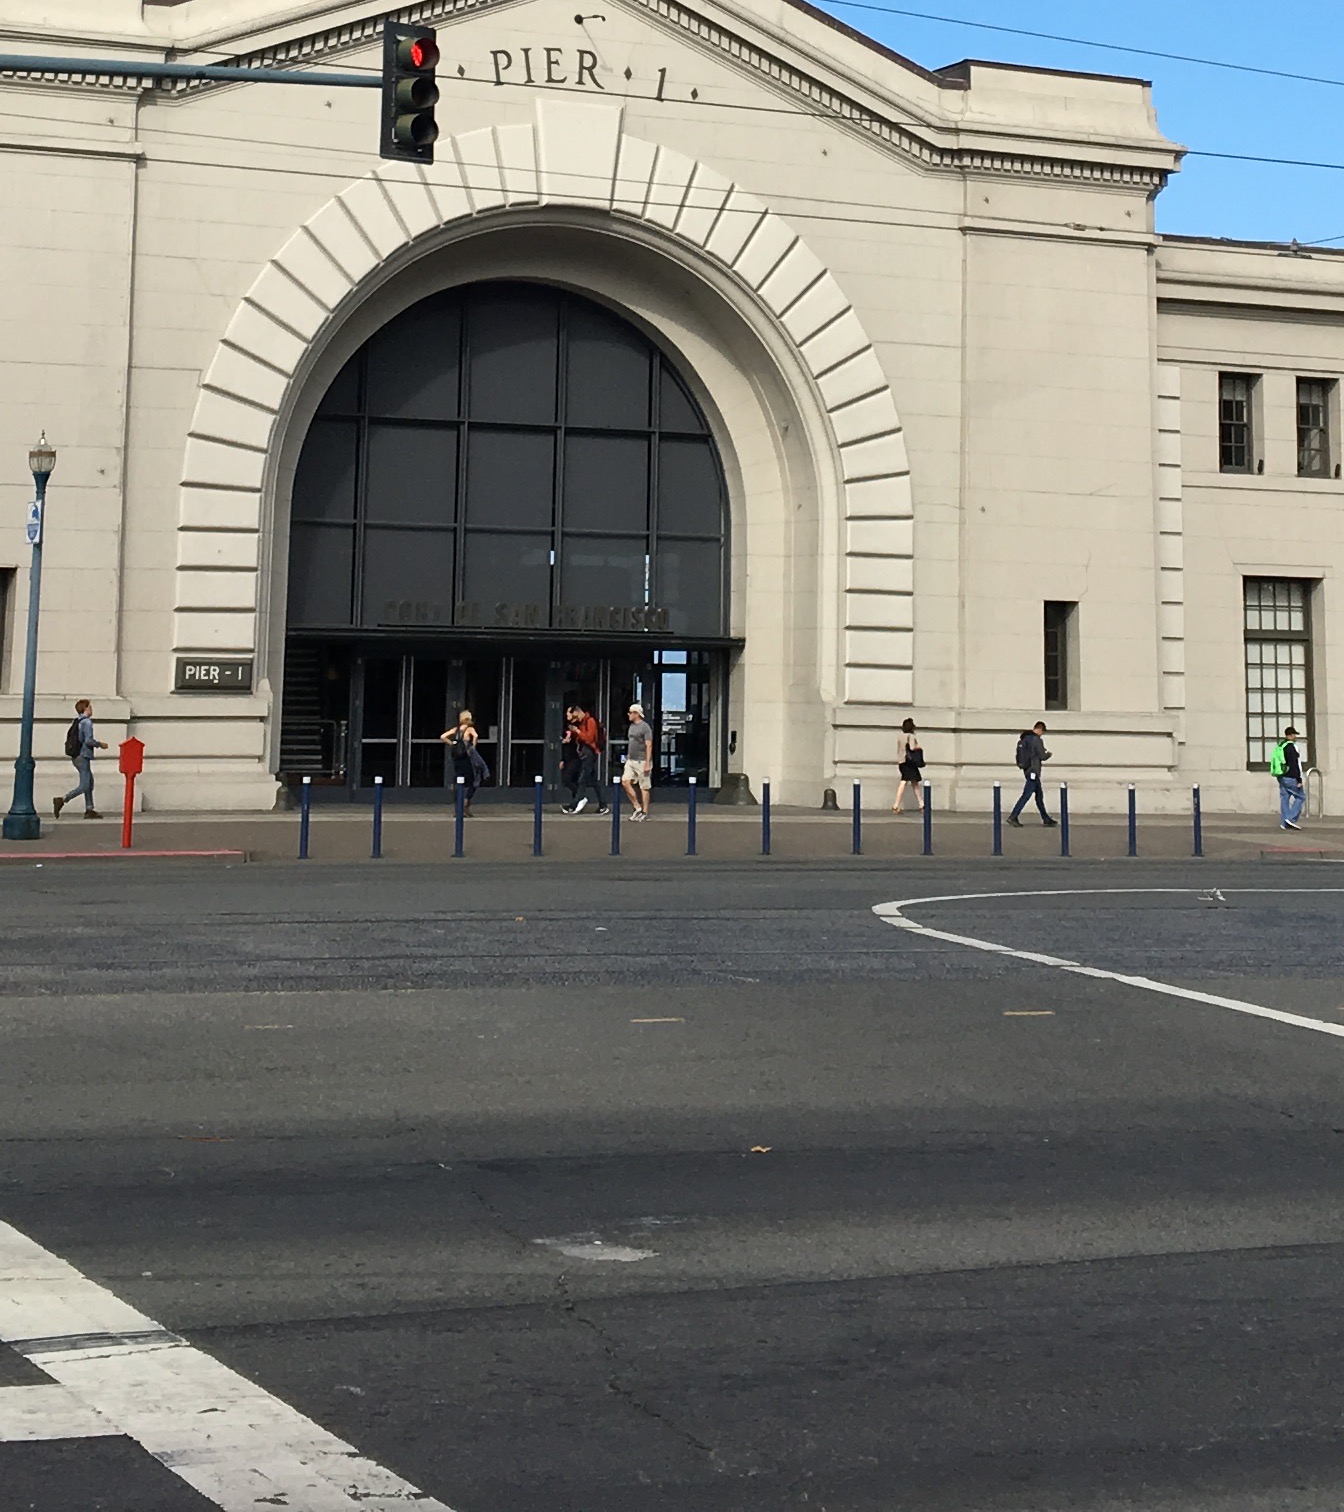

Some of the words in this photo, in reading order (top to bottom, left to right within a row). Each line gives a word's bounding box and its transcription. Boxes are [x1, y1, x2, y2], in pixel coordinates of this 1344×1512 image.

[489, 47, 605, 90] PIER
[654, 67, 667, 102] 1
[185, 665, 220, 680] PIER
